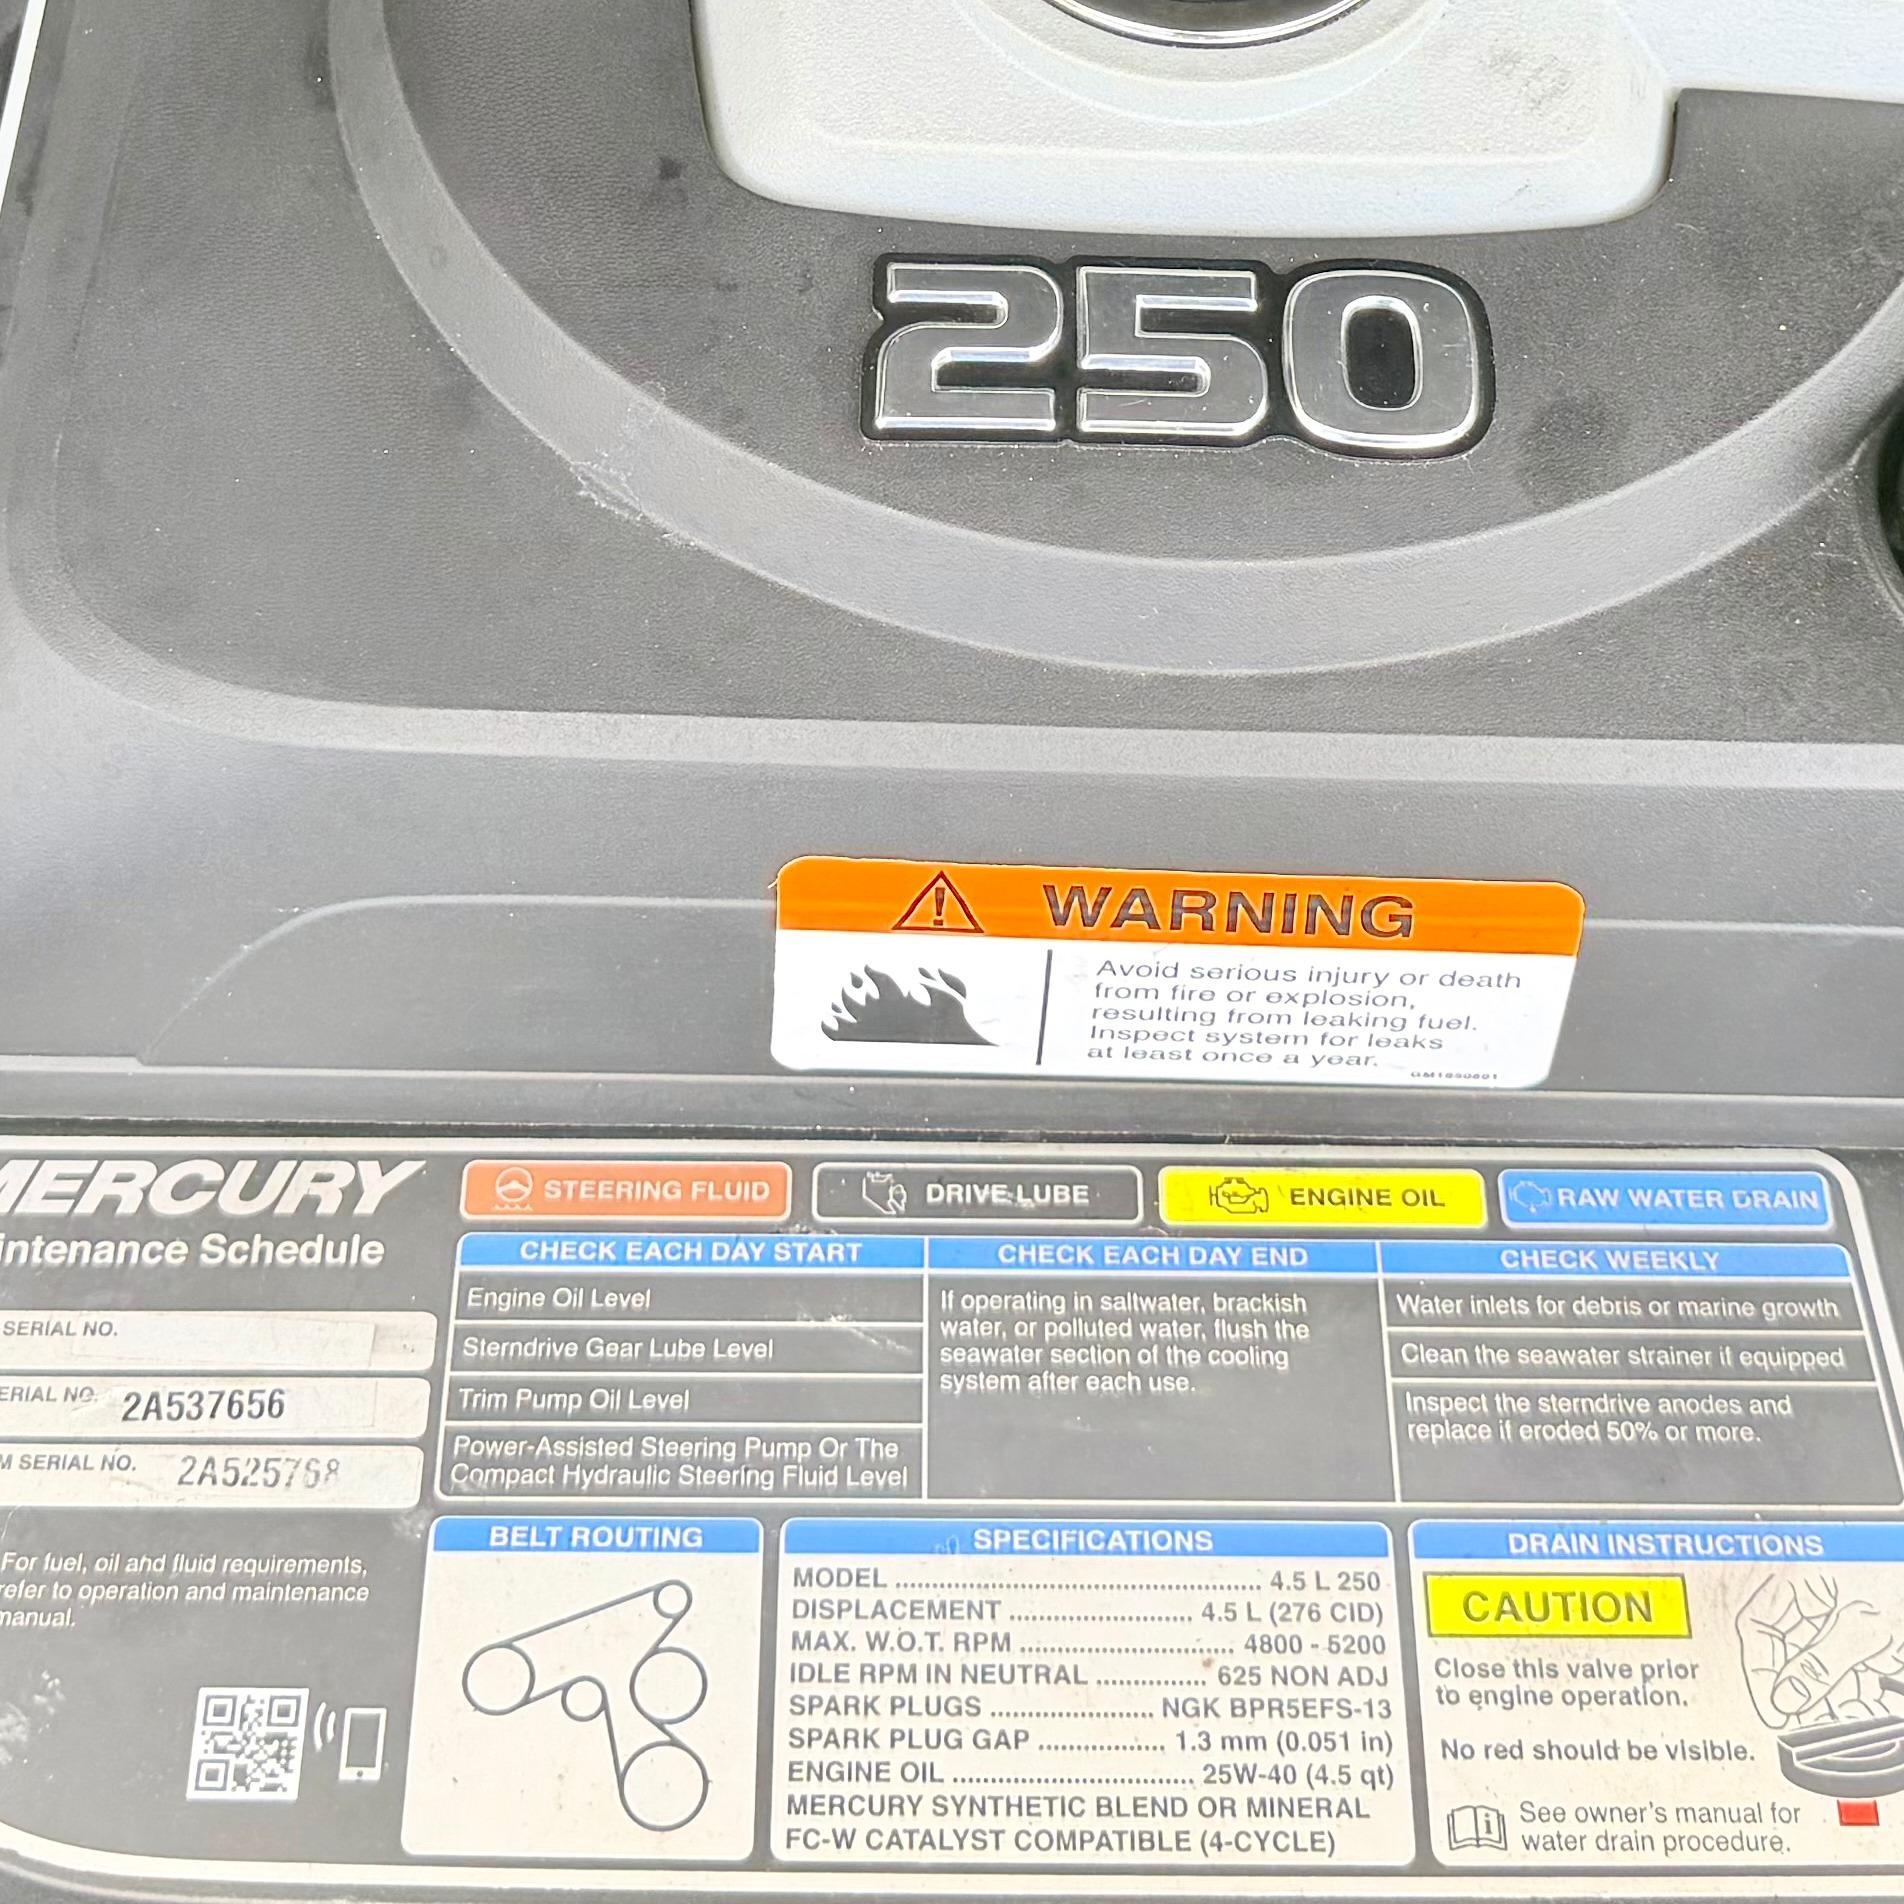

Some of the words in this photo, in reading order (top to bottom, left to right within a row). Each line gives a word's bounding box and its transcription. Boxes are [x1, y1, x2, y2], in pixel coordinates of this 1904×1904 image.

[874, 262, 1482, 450] 250
[1043, 885, 1412, 937] WARNING
[1097, 960, 1178, 978] Avoid
[1191, 964, 1296, 982] serious
[1309, 967, 1389, 988] injury
[1400, 974, 1428, 985] or
[1439, 971, 1520, 988] death
[1096, 983, 1158, 999] from
[1172, 985, 1215, 1001] fire
[1227, 991, 1256, 1002] or
[1266, 990, 1414, 1009] explosion,
[1091, 1006, 1216, 1026] resulting
[1229, 1009, 1291, 1024] from
[1304, 1011, 1406, 1032] leaking
[1419, 1014, 1476, 1030] fuel.
[1090, 1025, 1195, 1043] Inspect
[1205, 1031, 1309, 1046] system
[1321, 1032, 1358, 1046] for
[1368, 1034, 1442, 1049] leaks
[1087, 1047, 1113, 1059] at
[1123, 1046, 1193, 1061] least
[1202, 1050, 1273, 1063] once
[1283, 1053, 1299, 1064] a
[1311, 1054, 1379, 1068] year.
[545, 1180, 681, 1200] STEERING
[692, 1181, 769, 1202] FLUID
[926, 1183, 1009, 1206] DRIVE
[1017, 1184, 1090, 1206] LUBE
[1291, 1188, 1392, 1206] ENGINE
[1402, 1189, 1445, 1206] OIL
[1558, 1189, 1619, 1207] RAW
[1628, 1189, 1724, 1209] WATER
[1733, 1190, 1820, 1210] DRAIN
[200, 1233, 384, 1267] Schedule
[521, 1241, 616, 1260] CHECK
[627, 1241, 702, 1261] EACH
[712, 1242, 765, 1261] DAY
[775, 1242, 862, 1262] START
[999, 1244, 1094, 1264] CHECK
[1104, 1246, 1179, 1265] EACH
[1190, 1247, 1241, 1265] DAY
[1252, 1247, 1308, 1266] END
[1501, 1250, 1598, 1269] CHECK
[1606, 1251, 1718, 1271] WEEKLY
[467, 1288, 545, 1312] Engine
[553, 1288, 583, 1308] Oil
[591, 1289, 650, 1310] Level
[942, 1290, 953, 1312] If
[961, 1291, 1065, 1315] operating
[1074, 1291, 1092, 1312] in
[1101, 1292, 1205, 1314] saltwater,
[1213, 1292, 1307, 1314] brackish
[3, 1321, 76, 1336] SERIAL
[83, 1321, 117, 1336] NO.
[463, 1337, 578, 1359] Sterndrive
[586, 1337, 643, 1359] Gear
[650, 1338, 705, 1360] Lube
[714, 1338, 773, 1360] Level
[122, 1389, 284, 1421] 2A537656
[1406, 1391, 1488, 1418] Inspect
[1495, 1392, 1530, 1415] the
[1538, 1393, 1650, 1415] sterndrive
[1659, 1395, 1742, 1415] anodes
[1750, 1395, 1792, 1417] and
[19, 1455, 94, 1470] SERIAL
[101, 1455, 136, 1471] NO.
[487, 1526, 564, 1549] BELT
[573, 1526, 703, 1549] ROUTING
[975, 1530, 1213, 1551] SPECIFICATIONS
[1509, 1533, 1600, 1554] DRAIN
[1608, 1534, 1824, 1556] INSTRUCTIONS
[794, 1568, 887, 1588] MODEL
[1271, 1571, 1306, 1591] 4.5
[1316, 1571, 1330, 1590] L
[1338, 1572, 1380, 1591] 250
[793, 1600, 1001, 1620] DISPLACEMENT
[1202, 1602, 1237, 1622] 4.5
[1247, 1602, 1261, 1622] L
[1270, 1602, 1321, 1627] (276
[1331, 1603, 1383, 1627] CID)
[1463, 1591, 1652, 1622] CAUTION
[792, 1631, 855, 1651] MAX.
[866, 1631, 944, 1652] W.O.T.
[954, 1632, 1010, 1652] RPM
[1244, 1634, 1302, 1654] 4800
[1328, 1635, 1385, 1654] 5200
[791, 1664, 849, 1683] IDLE
[860, 1664, 916, 1684] RPM
[927, 1664, 951, 1684] IN
[962, 1664, 1088, 1685] NEUTRAL
[1218, 1666, 1261, 1686] 625
[1271, 1666, 1328, 1686] NON
[1338, 1667, 1387, 1686] ADJ
[1435, 1658, 1505, 1678] Close
[1513, 1658, 1559, 1679] this
[1567, 1659, 1632, 1679] valve
[1641, 1659, 1699, 1684] prior
[790, 1696, 880, 1717] SPARK
[891, 1696, 981, 1717] PLUGS
[1163, 1698, 1220, 1718] NGK
[1231, 1698, 1391, 1719] BPR5EFS-13
[1436, 1686, 1460, 1705] to
[1469, 1686, 1553, 1710] engine
[1562, 1686, 1687, 1710] operation.
[789, 1728, 879, 1749] SPARK
[890, 1729, 962, 1749] PLUG
[973, 1729, 1029, 1750] GAP
[1176, 1731, 1211, 1751] 1.3
[1221, 1736, 1267, 1751] mm
[1277, 1730, 1348, 1756] (0.051
[1362, 1731, 1392, 1757] in)
[1441, 1739, 1475, 1760] No
[1485, 1739, 1523, 1760] red
[1533, 1739, 1620, 1760] should
[1627, 1740, 1657, 1760] be
[1666, 1739, 1754, 1761] visible.
[789, 1761, 890, 1782] ENGINE
[901, 1762, 944, 1783] OIL
[1203, 1763, 1296, 1784] 25W-40
[1307, 1764, 1351, 1790] (4.5
[1361, 1764, 1393, 1791] qt)
[788, 1795, 922, 1816] MERCURY
[933, 1795, 1085, 1817] SYNTHETIC
[1097, 1796, 1187, 1817] BLEND
[1198, 1797, 1236, 1818] OR
[1247, 1797, 1370, 1818] MINERAL
[786, 1828, 856, 1850] FC-W
[866, 1829, 1005, 1850] CATALYST
[1015, 1830, 1191, 1851] COMPATIBLE
[1201, 1830, 1335, 1857] (4-CYCLE)
